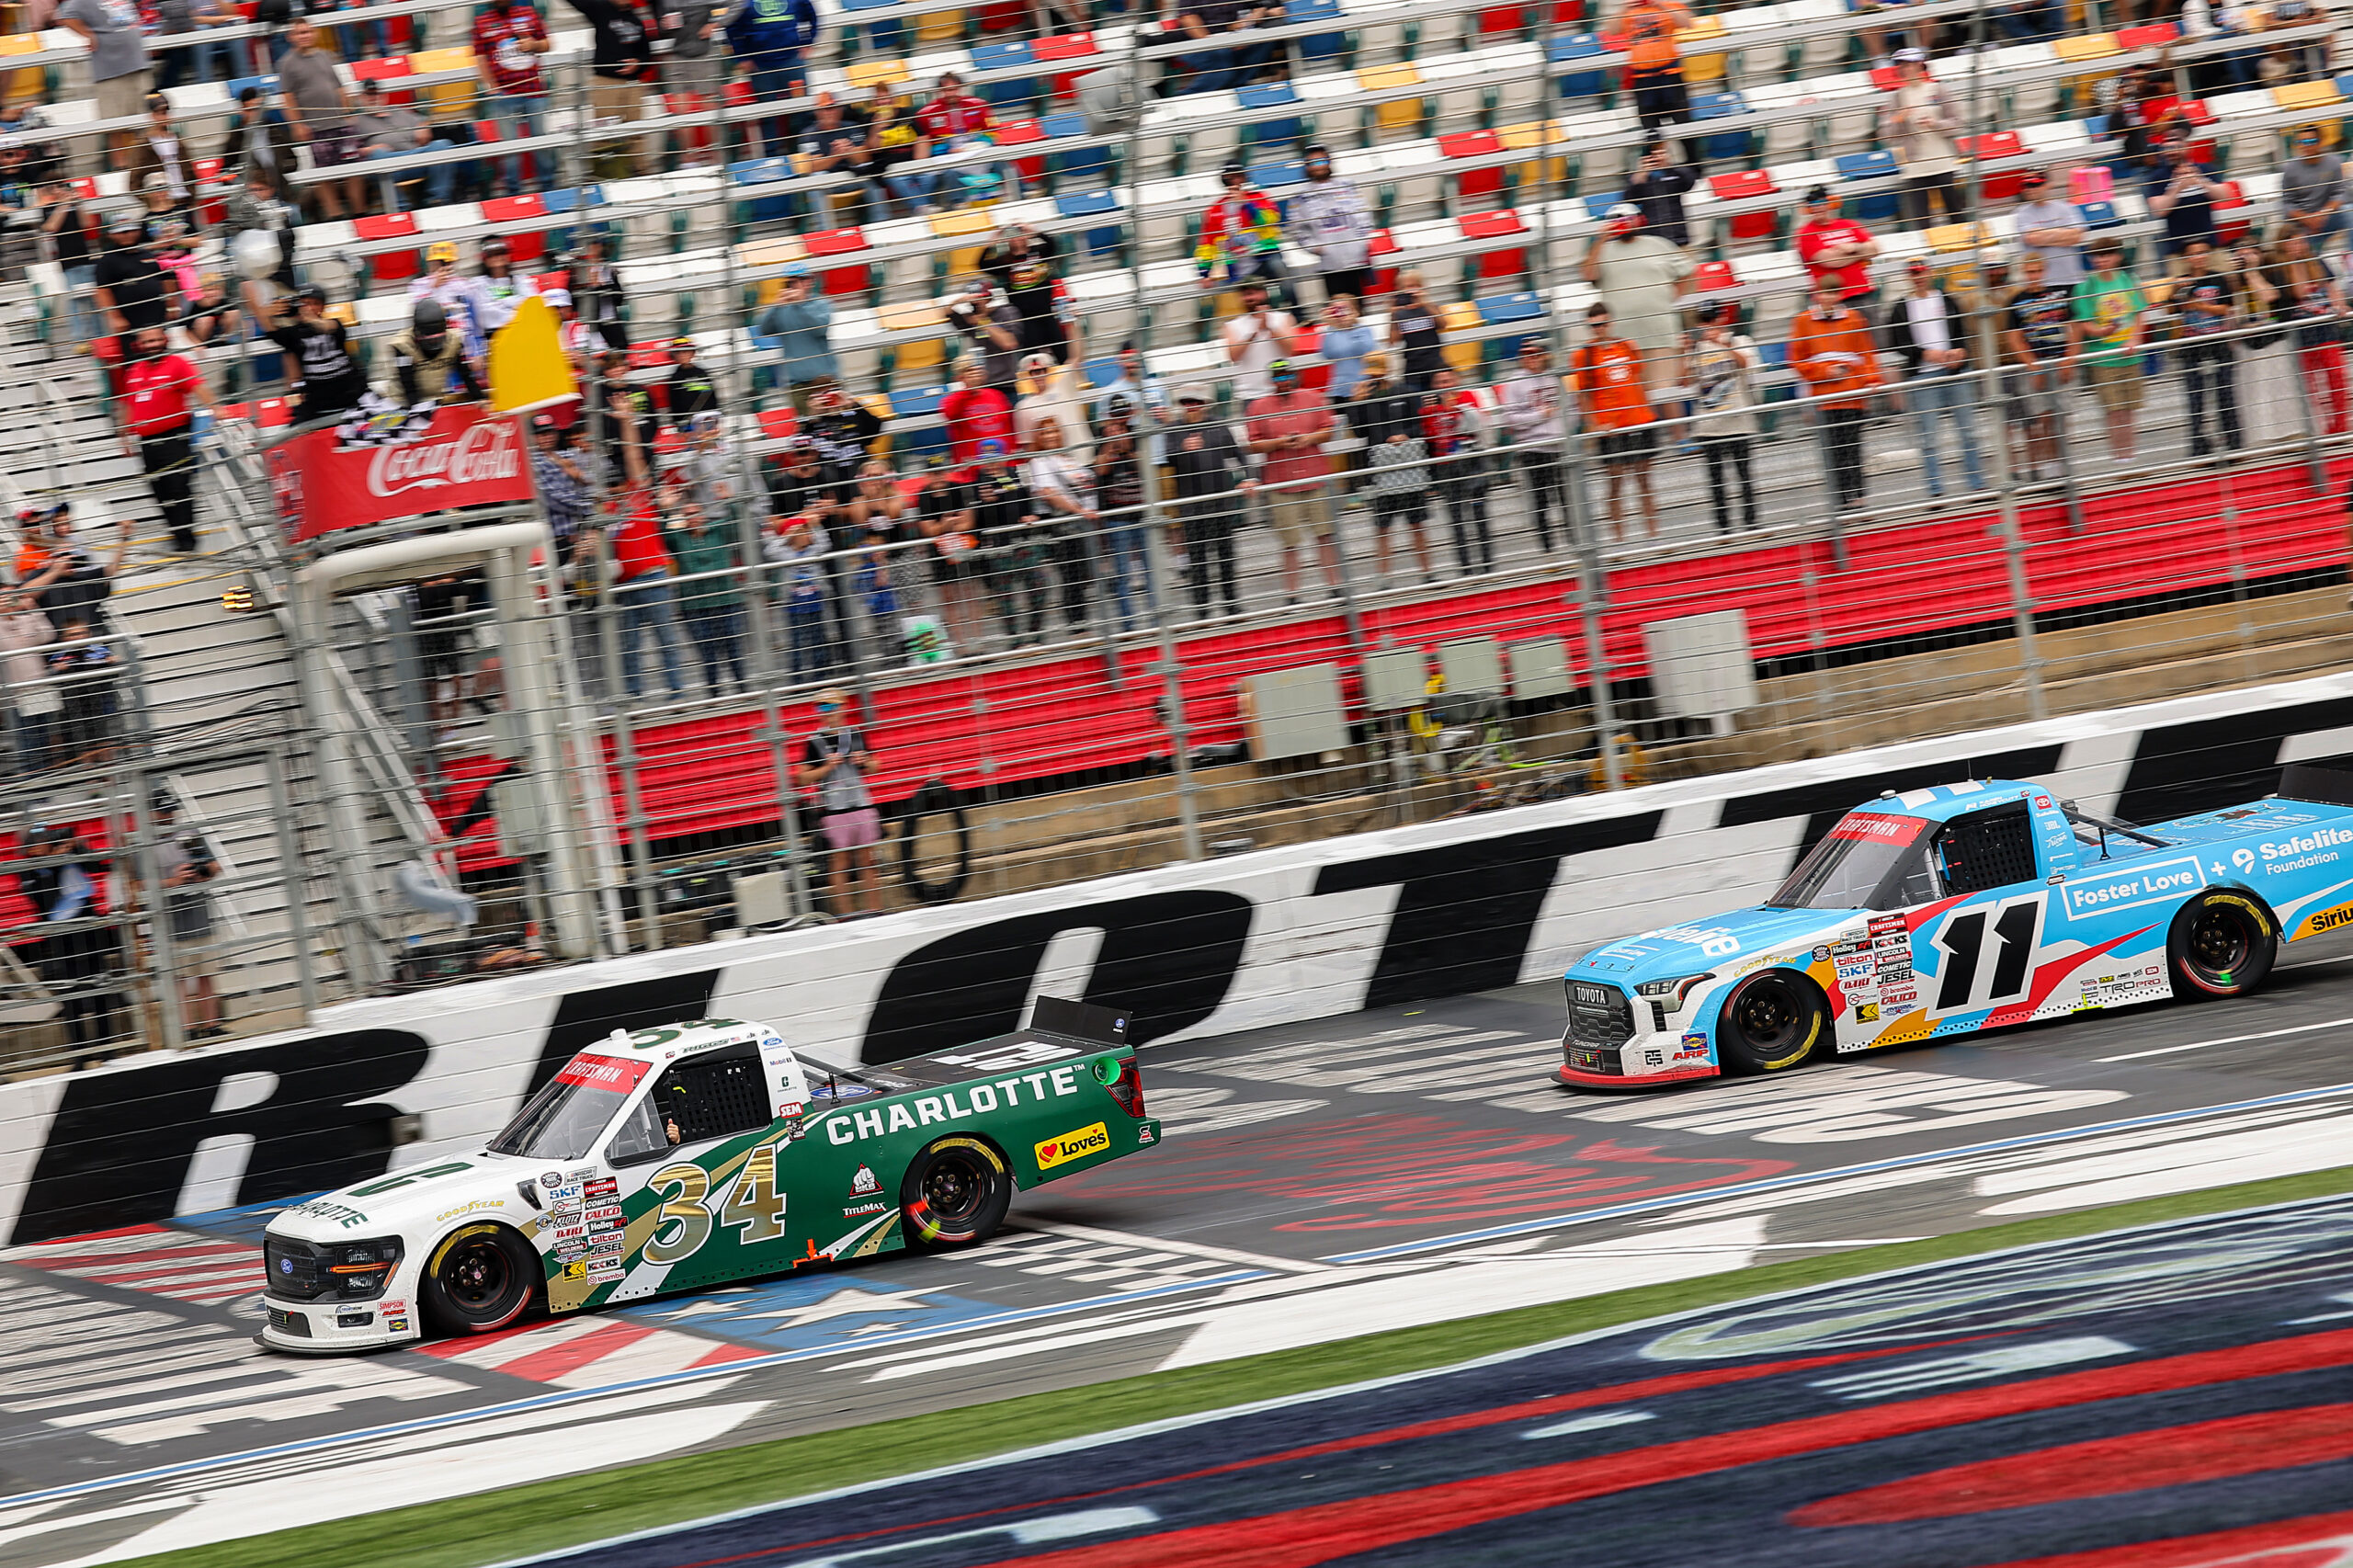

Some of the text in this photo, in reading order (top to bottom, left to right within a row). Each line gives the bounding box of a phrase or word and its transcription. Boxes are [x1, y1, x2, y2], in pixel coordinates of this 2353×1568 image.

[1839, 818, 1901, 837] CRAFTSMAN
[2259, 827, 2353, 860] Safelite
[2266, 851, 2339, 875] Foundation
[2073, 881, 2139, 907] Foster
[2143, 870, 2194, 893] Love
[1870, 919, 1905, 931] CRAFTSMAN
[1833, 944, 1857, 955] Holley
[1878, 948, 1905, 958] LINCOLN
[1935, 901, 2039, 1010] 11
[1733, 953, 1797, 977] GOODYEAR
[1836, 954, 1872, 966] tilton
[1839, 963, 1873, 978] SKF
[1877, 970, 1915, 985] JESEL
[2099, 981, 2135, 994] TRD
[2135, 978, 2161, 988] PRO
[1576, 986, 1606, 1005] TOYOTA
[1881, 992, 1917, 1005] CALICO
[1673, 1049, 1709, 1061] ARP
[564, 1061, 624, 1084] CRAFTSMAN
[780, 1103, 802, 1118] SEM
[826, 1066, 1078, 1146] CHARLOTTE
[550, 1185, 581, 1199] SKF
[585, 1182, 616, 1193] CRAFTSMAN
[436, 1199, 505, 1221] GOODYEAR
[642, 1143, 787, 1266] 34
[555, 1214, 580, 1225] KLOTZ
[585, 1207, 621, 1221] CALICO
[591, 1221, 614, 1232] Holley
[553, 1239, 581, 1249] LINCOLN
[590, 1233, 622, 1244] tilton
[591, 1243, 624, 1256] JESEL
[597, 1272, 625, 1281] brembo
[379, 1301, 404, 1311] SIMPSON
